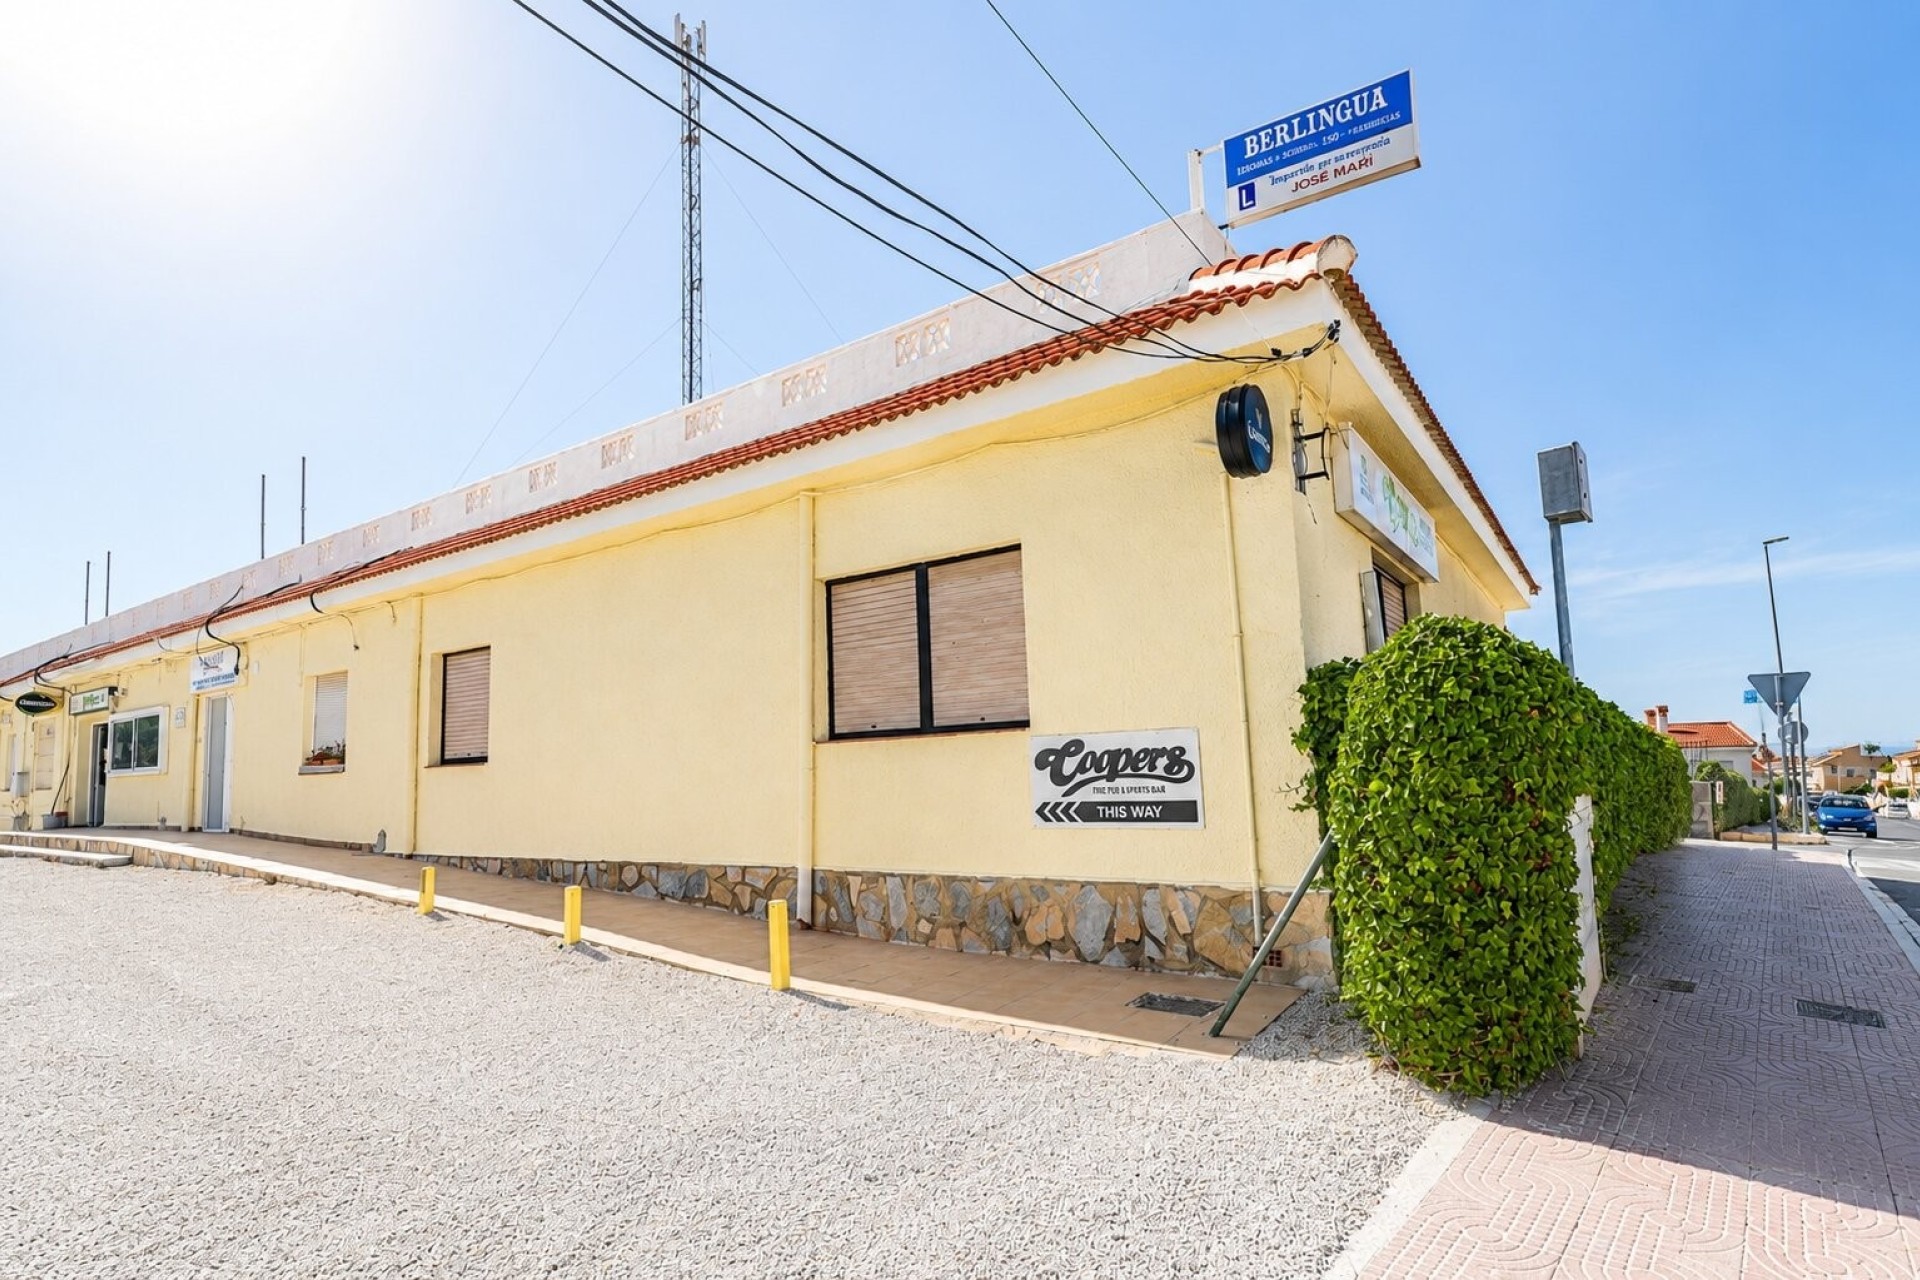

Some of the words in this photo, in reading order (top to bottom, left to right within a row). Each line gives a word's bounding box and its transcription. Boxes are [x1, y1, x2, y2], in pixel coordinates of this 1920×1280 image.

[1244, 85, 1389, 159] BERLINGUA
[1242, 189, 1254, 207] L
[1034, 738, 1195, 798] Coopers
[1096, 805, 1127, 818] THIS
[1130, 804, 1163, 818] WAY
